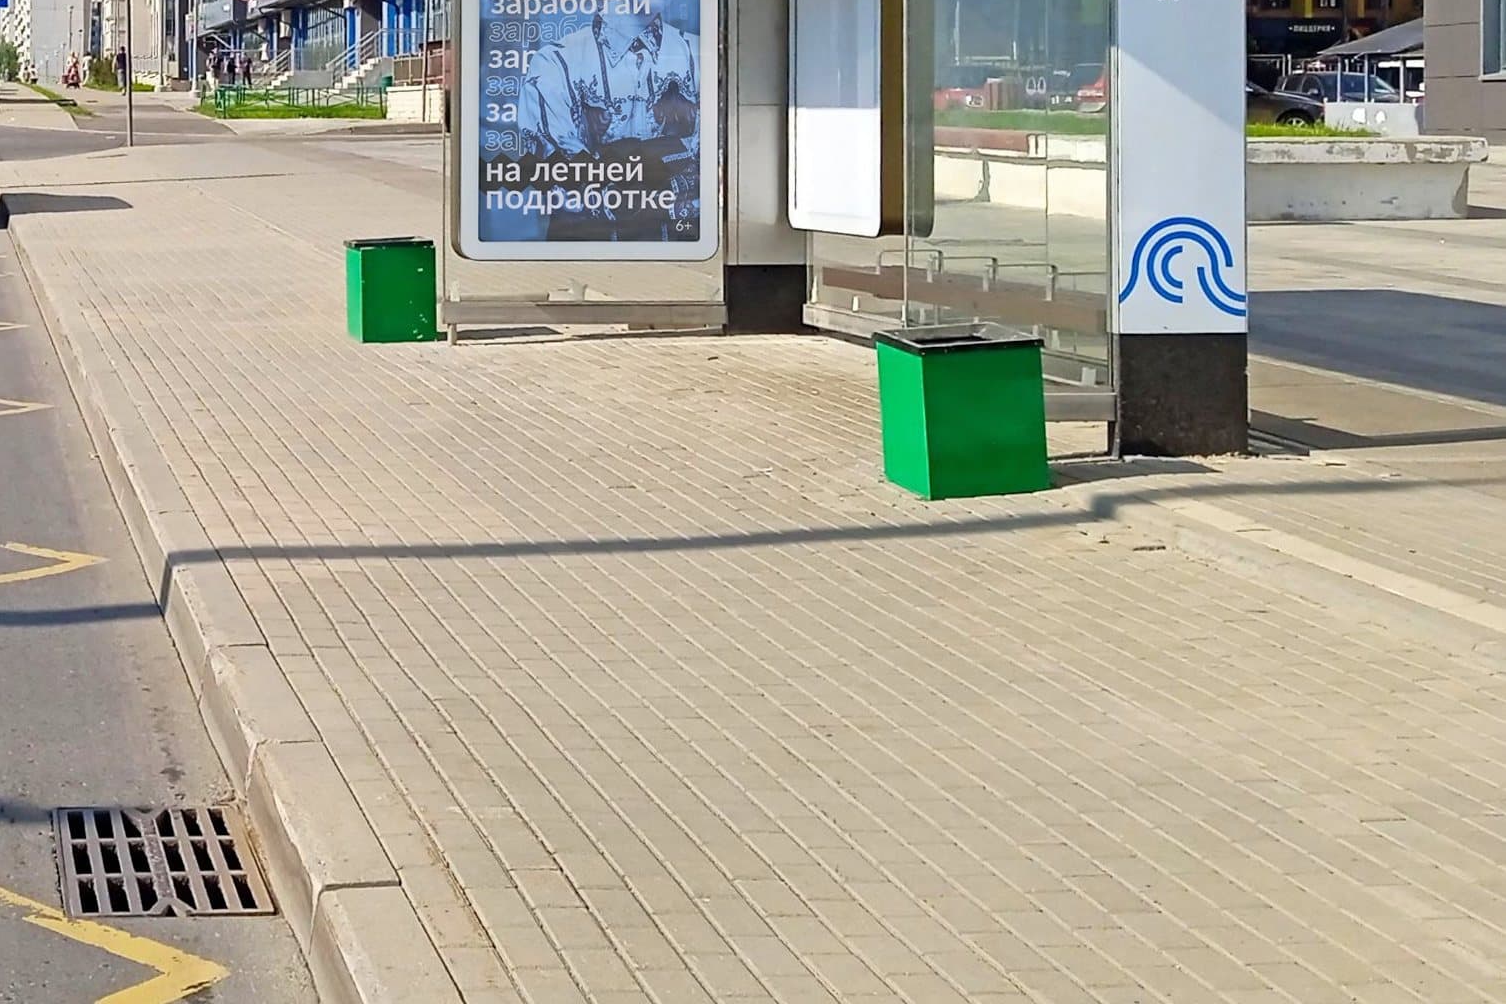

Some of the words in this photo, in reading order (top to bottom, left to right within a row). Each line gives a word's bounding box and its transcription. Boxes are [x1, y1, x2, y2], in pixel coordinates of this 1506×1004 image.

[486, 103, 517, 122] за
[486, 162, 521, 182] на
[530, 156, 643, 182] летней
[486, 183, 676, 215] подработке
[675, 220, 693, 231] 6+
